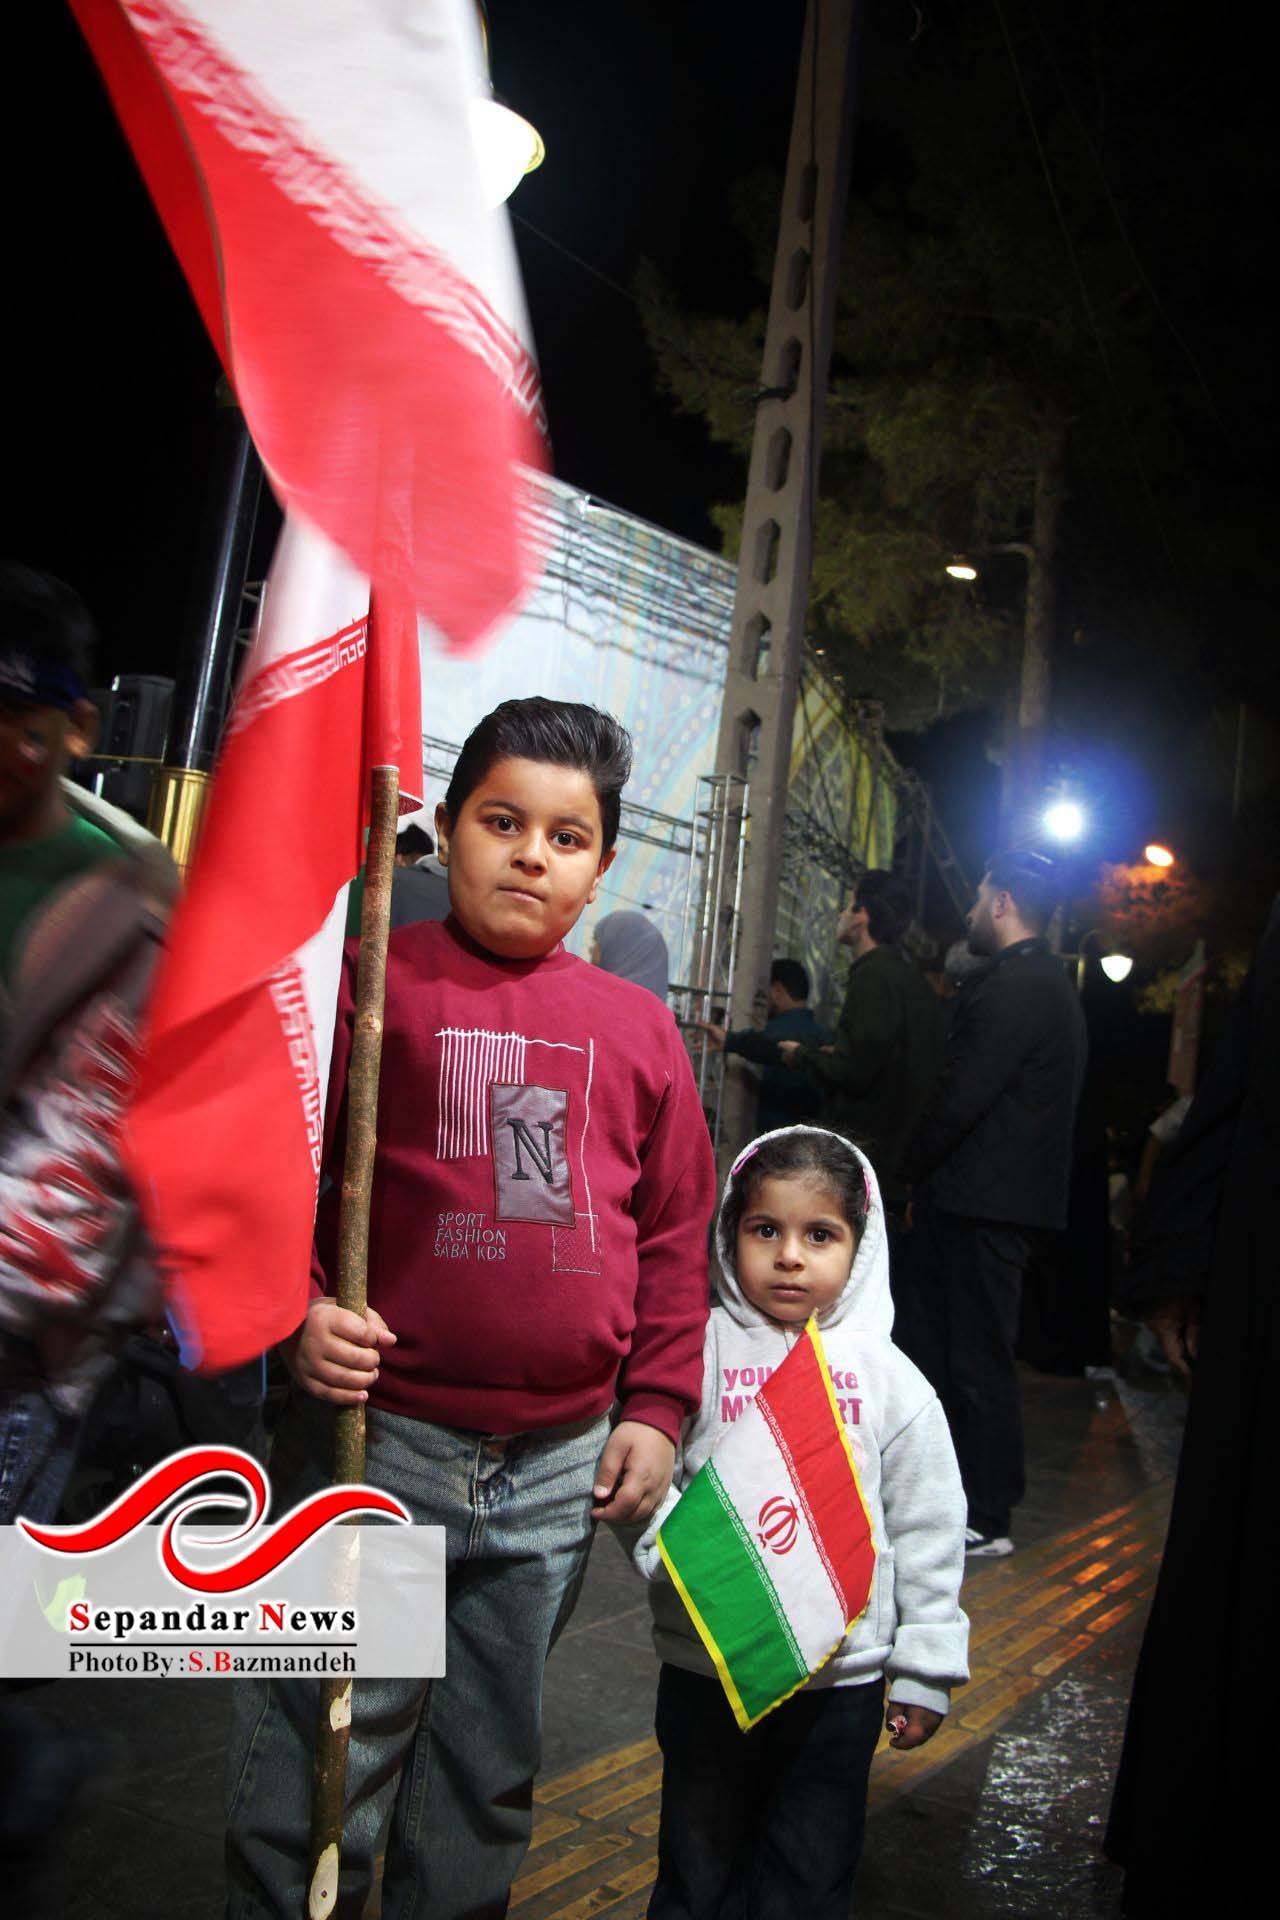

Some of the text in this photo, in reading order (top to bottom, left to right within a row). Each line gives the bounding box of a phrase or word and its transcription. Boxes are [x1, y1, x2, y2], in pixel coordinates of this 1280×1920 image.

[506, 1117, 554, 1184] N
[438, 1212, 486, 1227] SPORT
[436, 1228, 506, 1246] FASHION
[433, 1243, 469, 1259] SABA
[827, 1364, 859, 1390] ke
[721, 1395, 752, 1423] M
